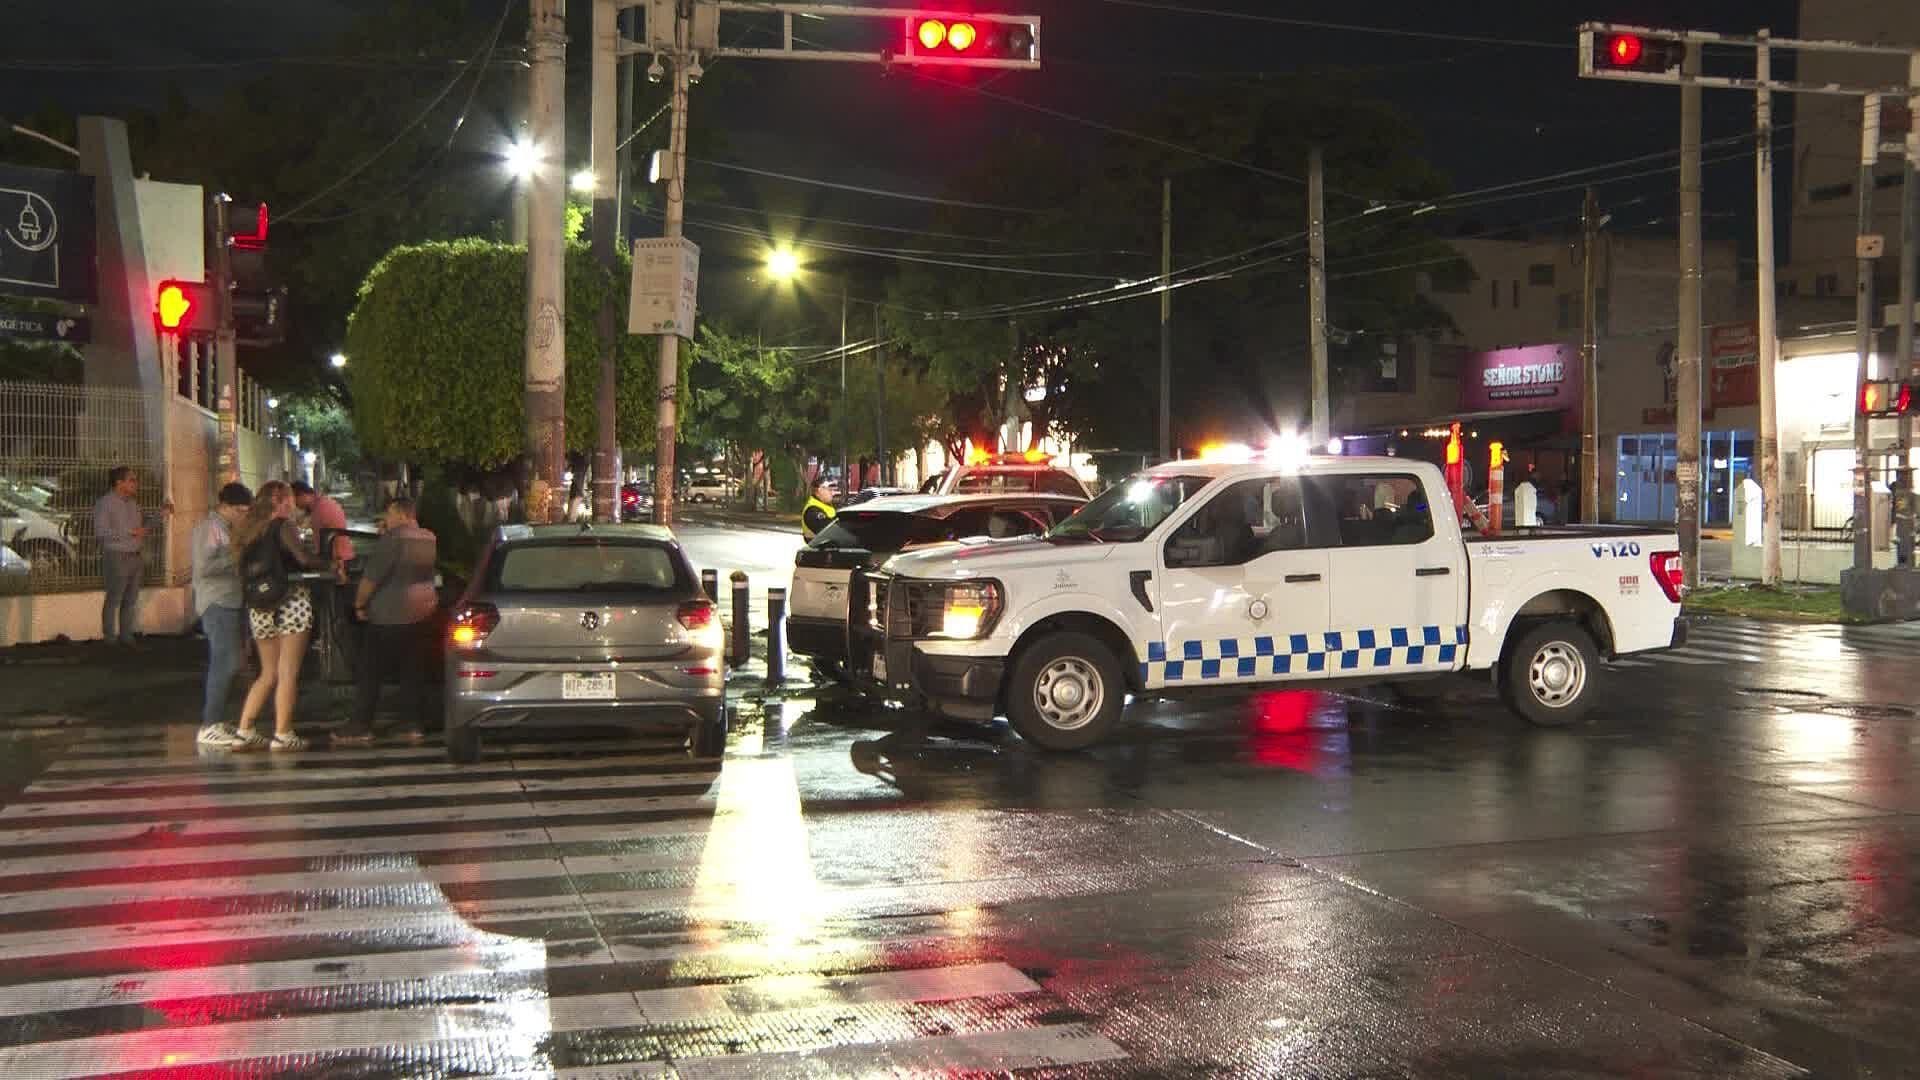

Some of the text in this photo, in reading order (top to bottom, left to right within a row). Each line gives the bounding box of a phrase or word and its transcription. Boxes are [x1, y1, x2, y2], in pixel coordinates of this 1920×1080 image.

[1483, 362, 1564, 386] SEÑOR STONE
[1591, 542, 1641, 558] V-120
